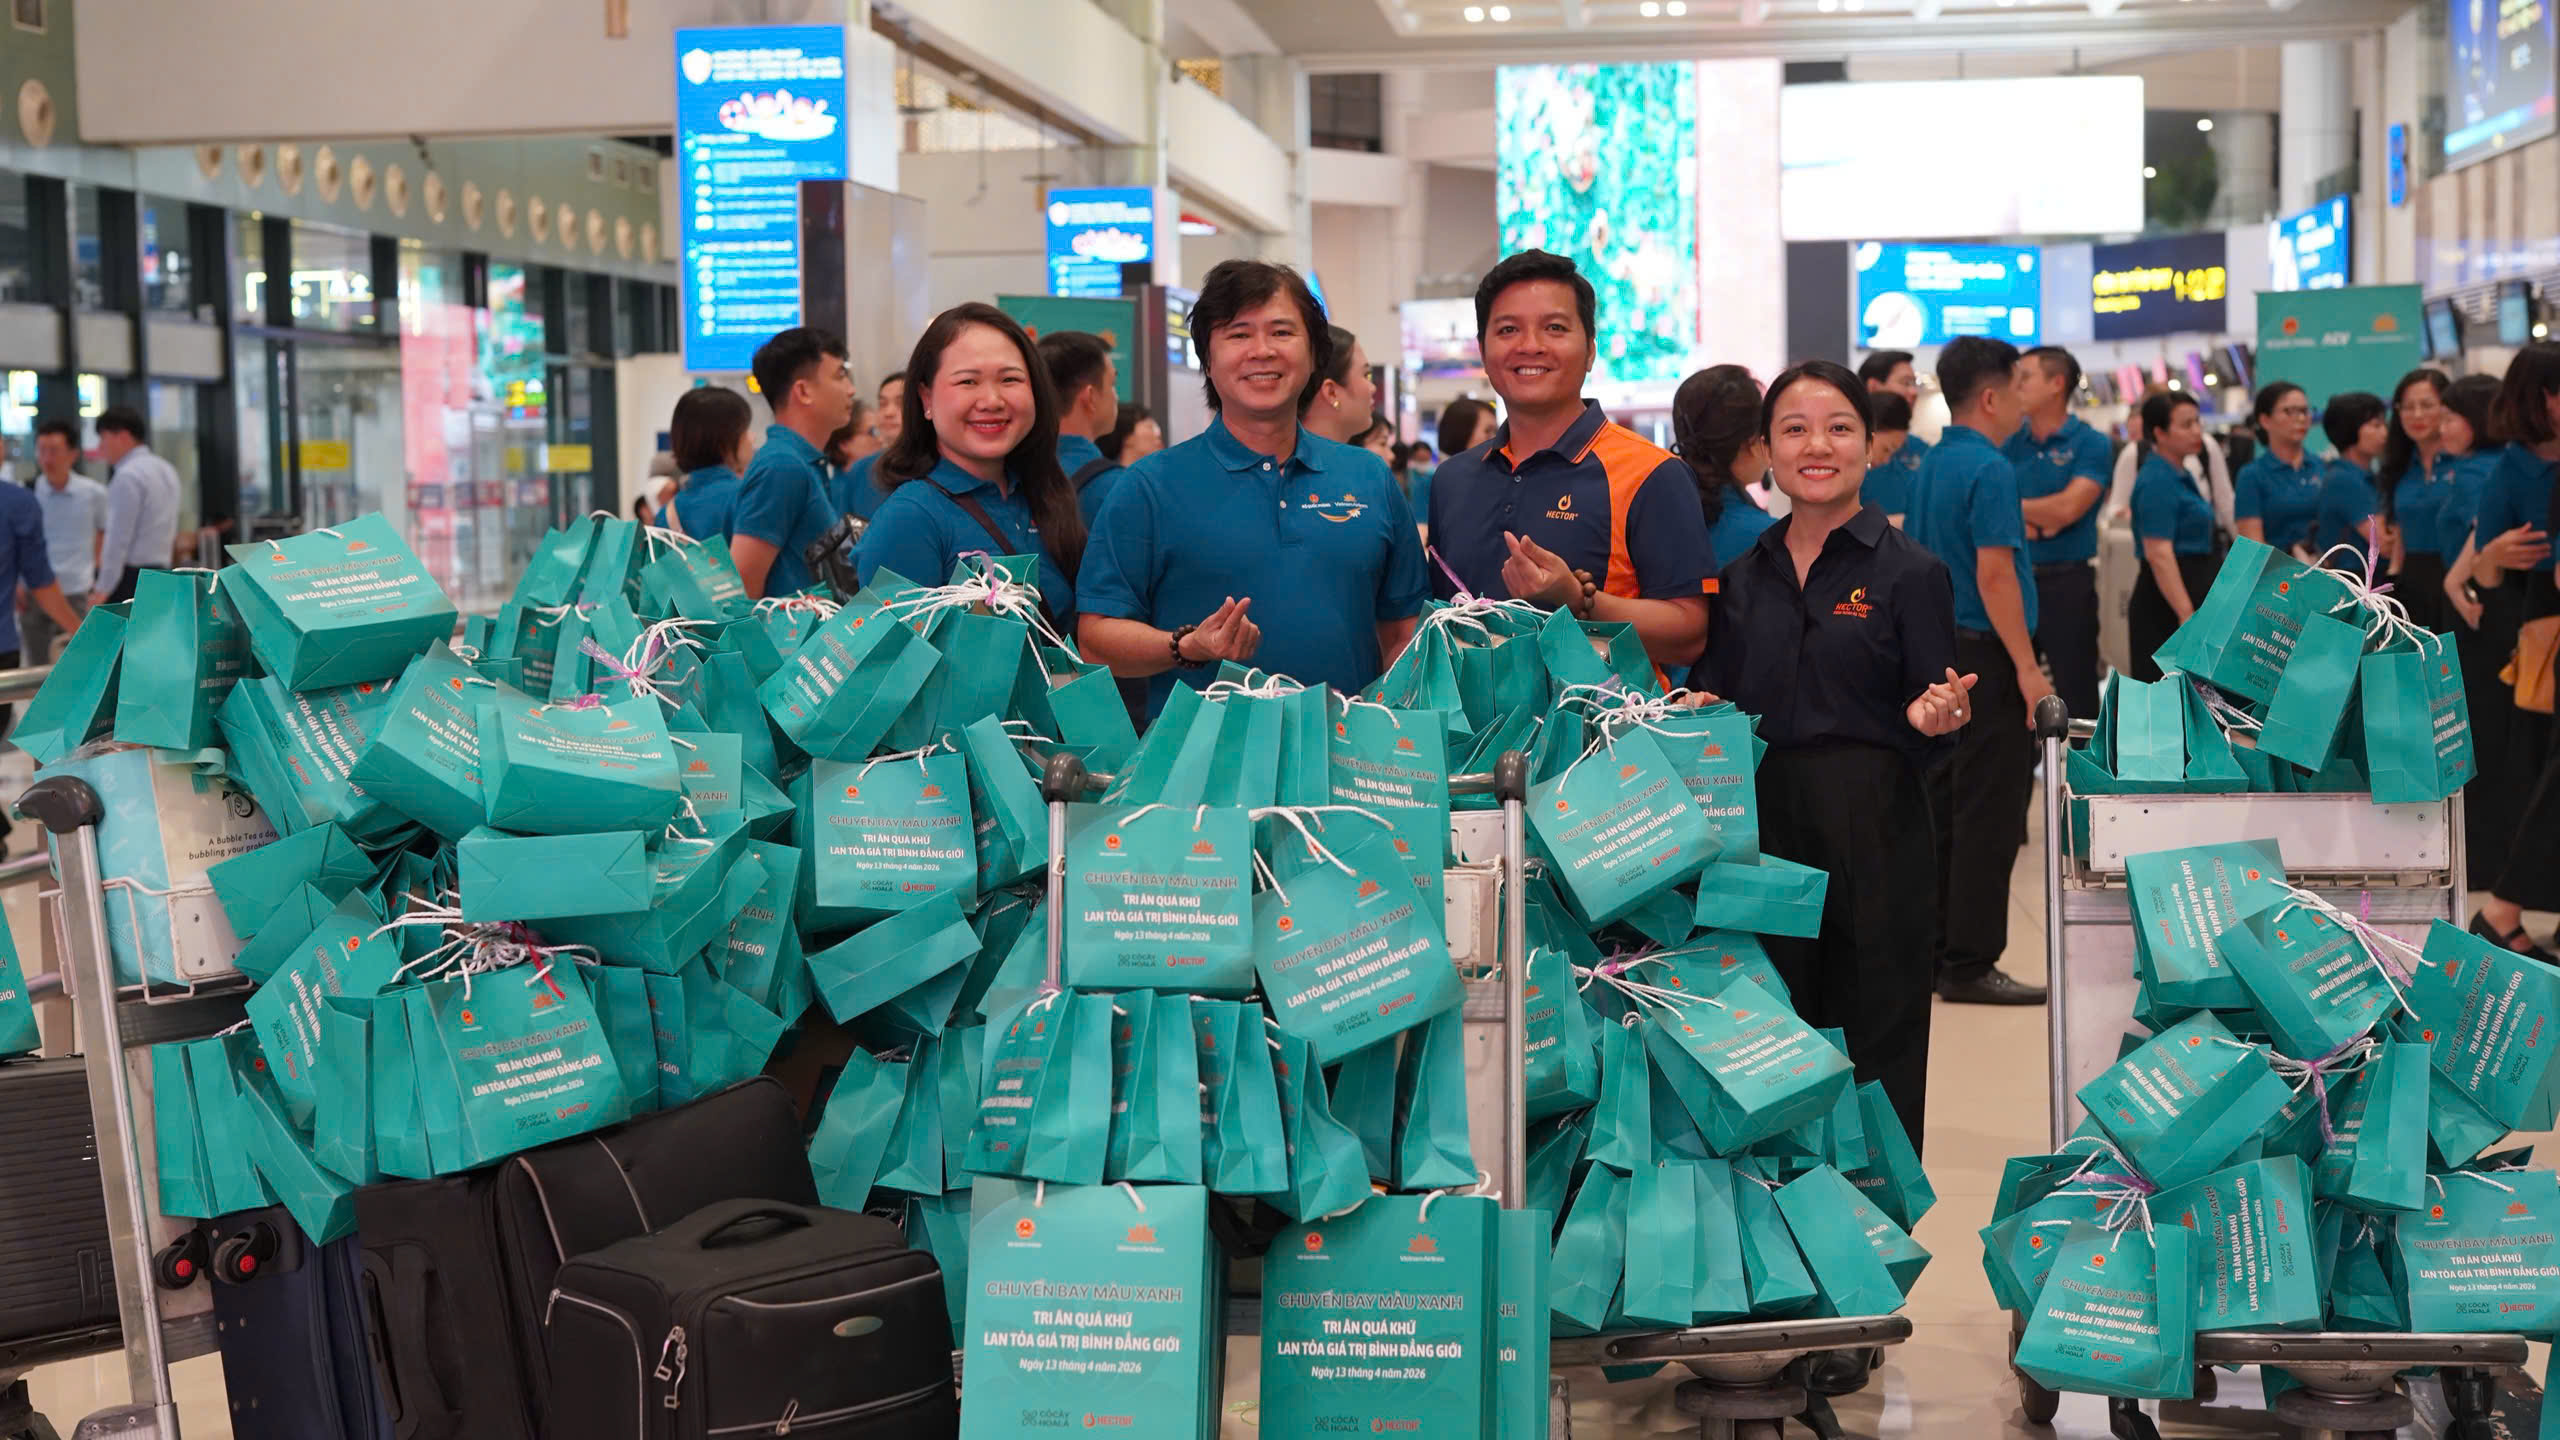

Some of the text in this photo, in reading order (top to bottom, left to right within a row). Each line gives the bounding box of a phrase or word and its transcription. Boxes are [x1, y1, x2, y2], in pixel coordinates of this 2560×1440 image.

[1712, 776, 1743, 784] XANH
[209, 838, 214, 846] A
[217, 834, 242, 844] Bubble
[245, 831, 256, 839] Tea
[862, 834, 876, 842] TRI
[189, 848, 225, 860] bubbling
[228, 846, 244, 856] your
[830, 846, 846, 854] LAN
[866, 847, 881, 856] GIÁ
[882, 848, 896, 857] TRỊ
[897, 848, 918, 856] BÌNH
[945, 848, 963, 858] GIỚI
[1123, 894, 1139, 904] TRI
[1155, 895, 1177, 906] QUÁ
[1084, 911, 1104, 921] LAN
[1126, 910, 1143, 922] GIÁ
[1145, 911, 1161, 923] TRỊ
[1161, 911, 1187, 923] BÌNH
[1217, 914, 1238, 925] GIỚI
[1315, 963, 1331, 976] TRI
[1345, 947, 1367, 964] QUÁ
[1287, 992, 1306, 1007] LAN
[1325, 976, 1343, 991] GIÁ
[1341, 970, 1358, 983] TRỊ
[1357, 959, 1382, 977] BÌNH
[1408, 938, 1429, 954] GIỚI
[2450, 1256, 2465, 1264] TRI
[2480, 1253, 2501, 1264] QUÁ
[2420, 1270, 2436, 1278] LAN
[2457, 1268, 2472, 1278] GIÁ
[2472, 1268, 2488, 1277] TRỊ
[2489, 1267, 2512, 1276] BÌNH
[2539, 1266, 2559, 1276] GIỚI
[1056, 1283, 1091, 1298] BAY
[1134, 1286, 1182, 1302] XANH
[1344, 1293, 1376, 1308] BAY
[1417, 1295, 1463, 1310] XANH
[1033, 1309, 1132, 1327] TRI ÂN QUÁ KHỨ
[1323, 1319, 1415, 1336] TRI ÂN QUÁ KHỨ
[983, 1330, 1179, 1352] LAN TỎA GIÁ TRỊ BÌNH ĐẲNG GIỚI
[1278, 1339, 1461, 1358] LAN TỎA GIÁ TRỊ BÌNH ĐẲNG GIỚI
[1019, 1358, 1141, 1373] Ngày 13 tháng 4 năm 2026
[1311, 1366, 1425, 1380] Ngày 13 tháng 4 năm 2026
